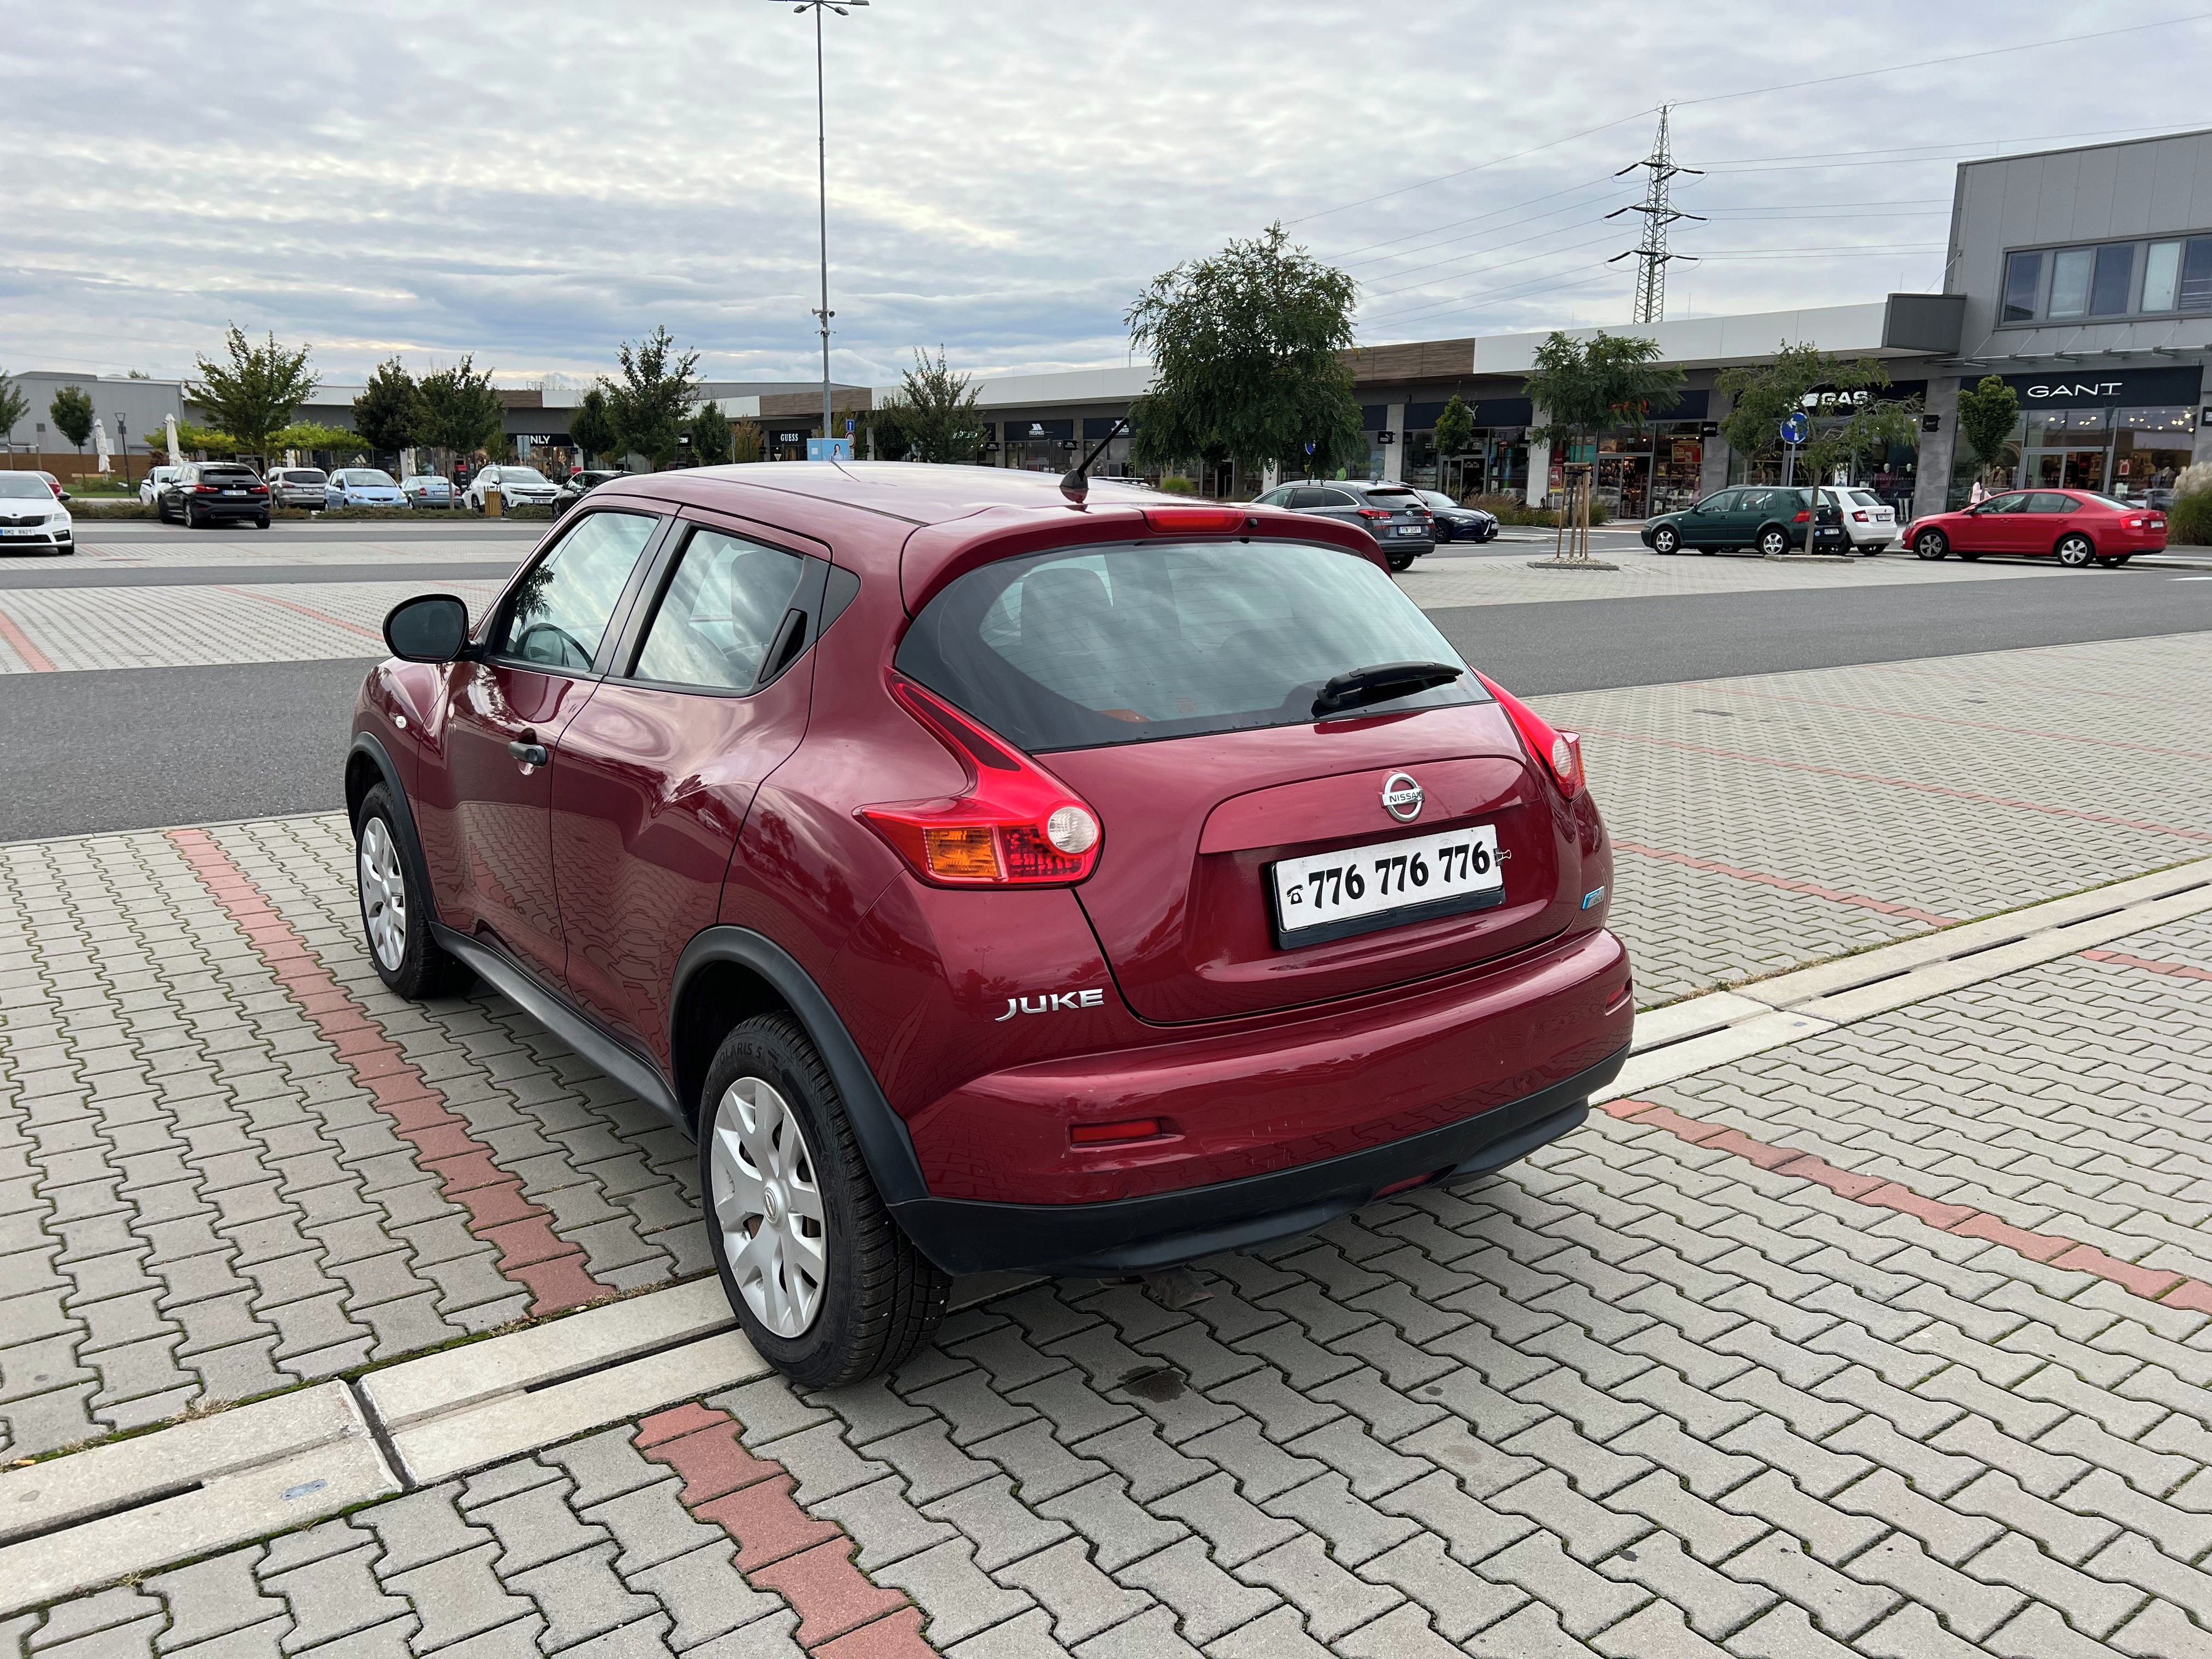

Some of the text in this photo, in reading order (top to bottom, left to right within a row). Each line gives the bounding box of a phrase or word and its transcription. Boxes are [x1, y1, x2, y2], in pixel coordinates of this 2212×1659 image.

[2028, 382, 2123, 398] GANT
[1821, 391, 1868, 406] GAS
[530, 435, 550, 444] NLY
[780, 433, 798, 442] GUESS
[1389, 792, 1422, 803] NISSAN
[1308, 840, 1490, 909] 776 776 776
[995, 988, 1104, 1022] JUKE
[715, 1042, 753, 1068] POLARIS
[756, 1046, 763, 1059] 5
